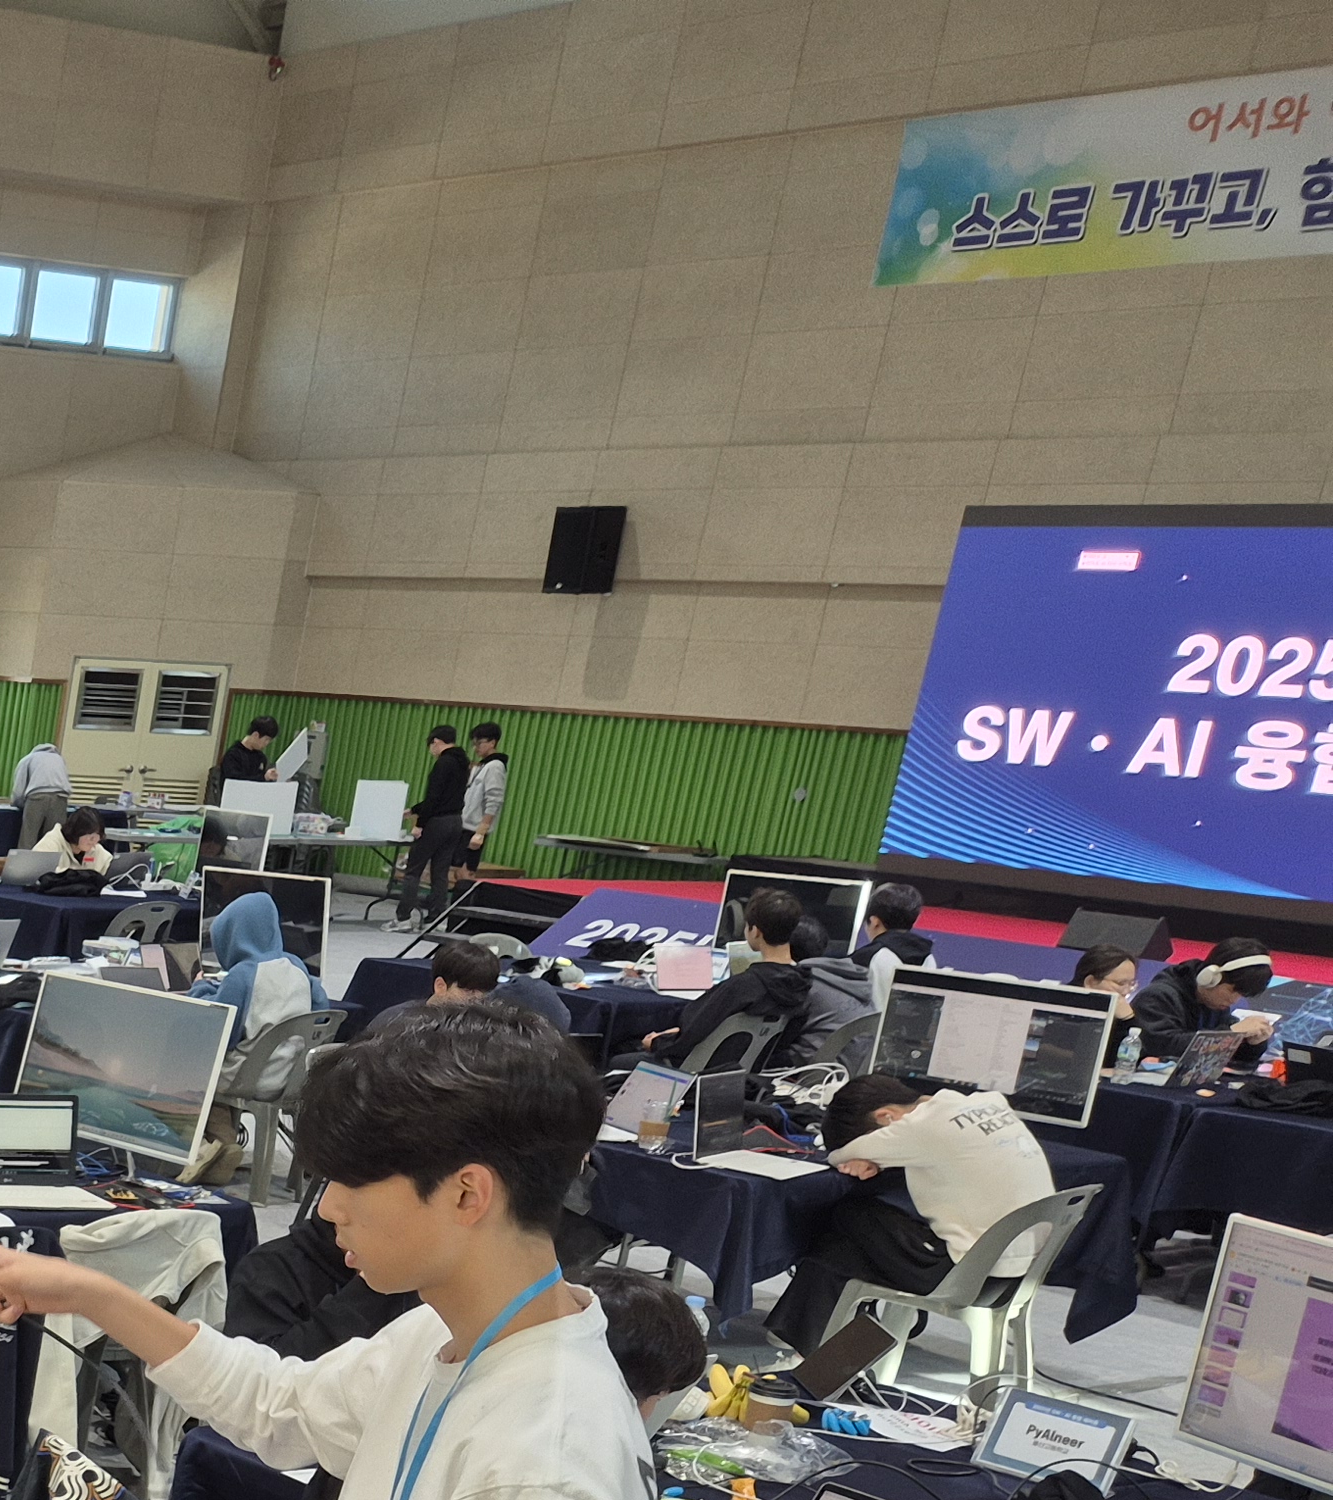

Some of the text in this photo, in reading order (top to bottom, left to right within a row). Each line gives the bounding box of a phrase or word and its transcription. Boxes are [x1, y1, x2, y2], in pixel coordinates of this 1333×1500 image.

[1188, 93, 1310, 142] 어서와
[952, 185, 1094, 251] 스스로
[1111, 168, 1277, 238] 가꾸고,
[956, 704, 1076, 766] SW
[1124, 717, 1214, 778] AI
